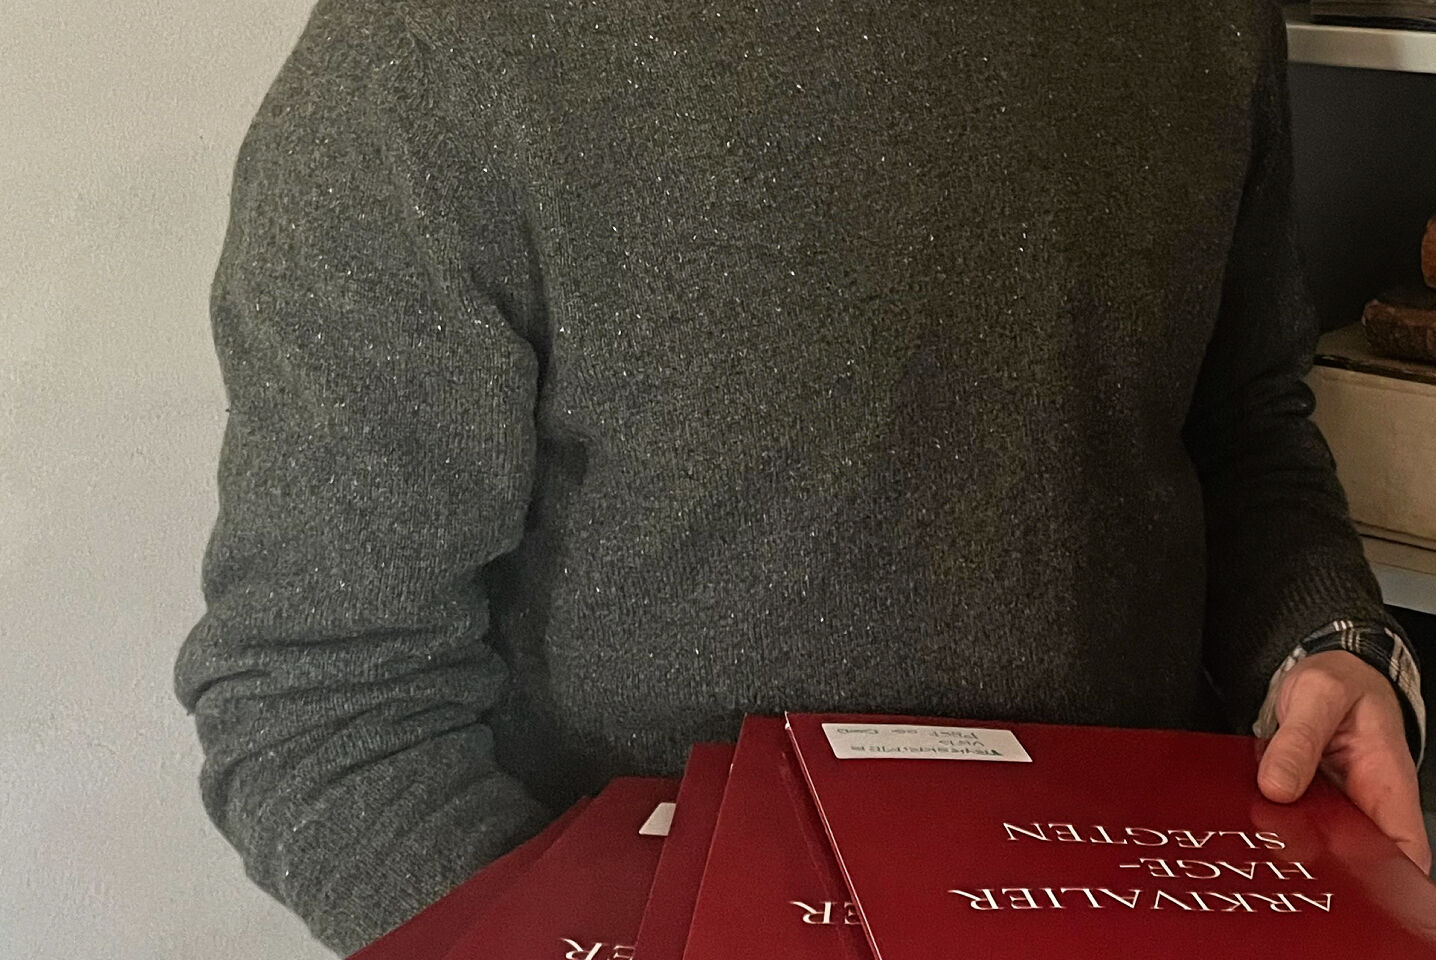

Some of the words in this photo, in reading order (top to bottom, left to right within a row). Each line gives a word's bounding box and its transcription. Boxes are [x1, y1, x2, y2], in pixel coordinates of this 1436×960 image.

[1002, 822, 1287, 850] SLÆGTEN
[1119, 857, 1318, 881] HAGE-
[947, 887, 1334, 913] ARKIVALIER
